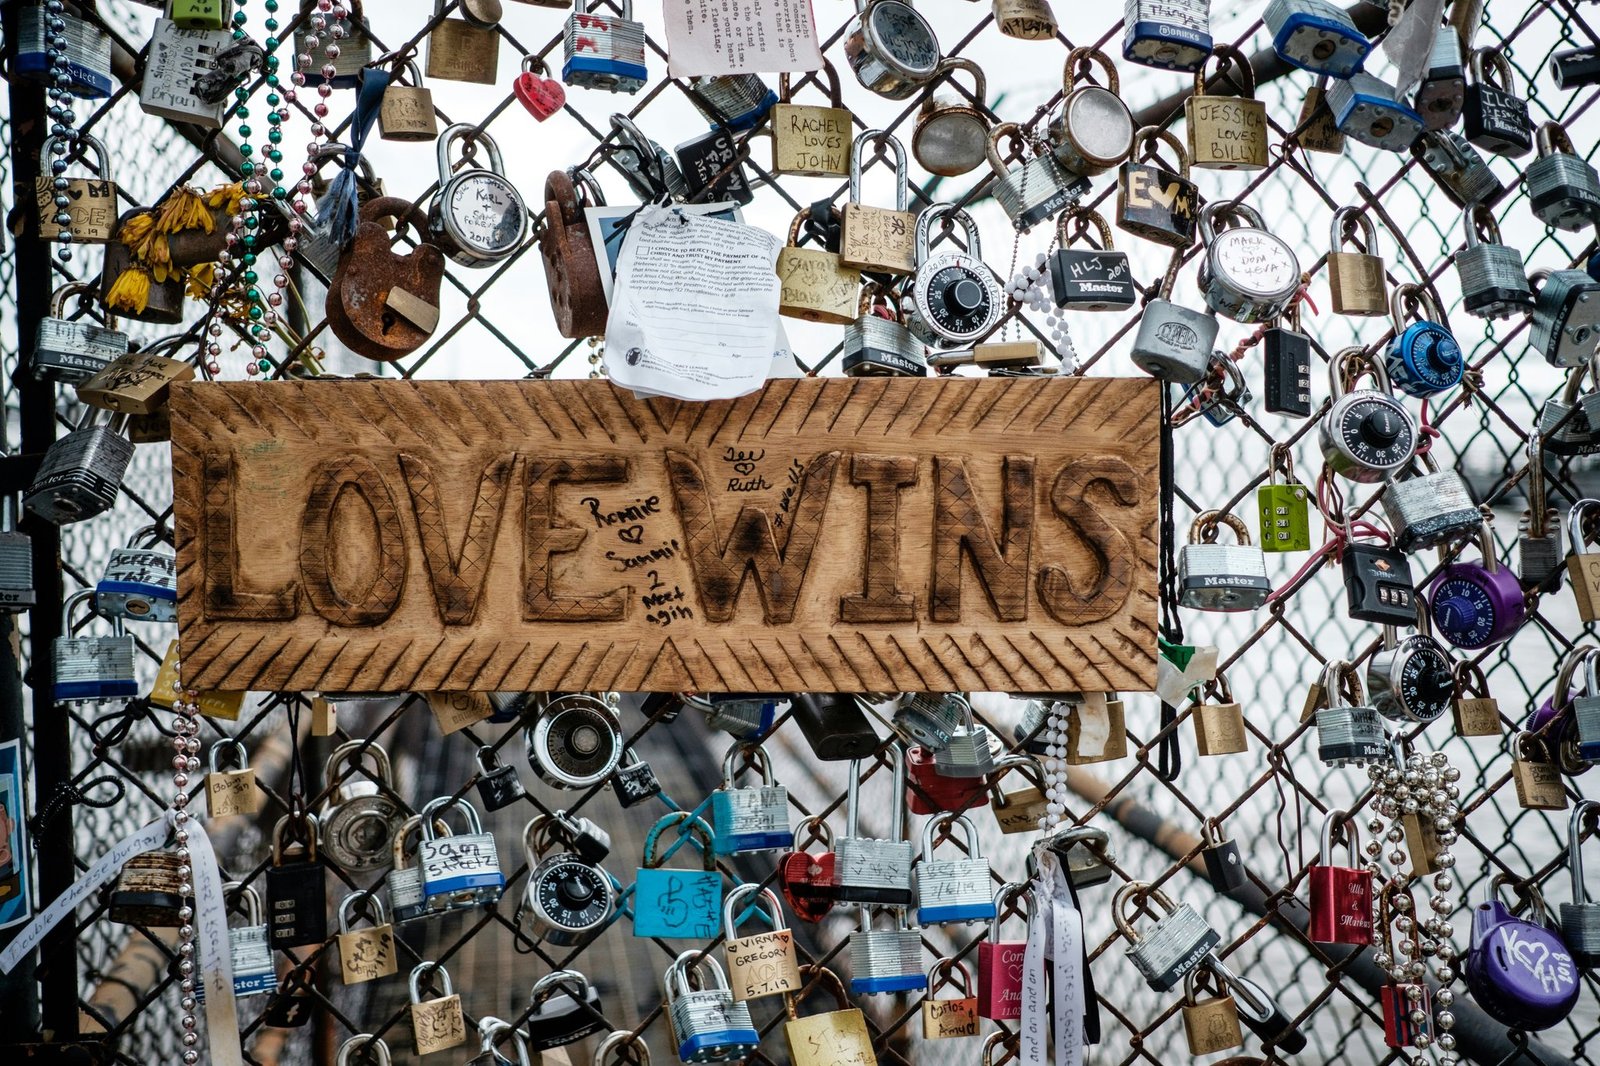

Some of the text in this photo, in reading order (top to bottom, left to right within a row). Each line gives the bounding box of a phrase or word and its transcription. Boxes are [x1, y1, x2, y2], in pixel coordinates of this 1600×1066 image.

[686, 9, 695, 36] them.
[743, 7, 751, 22] the
[775, 12, 784, 33] that
[722, 16, 737, 69] your heart
[735, 26, 746, 68] or time.
[787, 38, 797, 63] about
[66, 64, 98, 86] Select
[152, 86, 196, 107] Bryan
[1198, 104, 1263, 128] JESSICA
[791, 114, 845, 135] RACHEL
[803, 134, 842, 150] LOVES
[1217, 129, 1257, 142] LOVES
[1211, 141, 1259, 162] BILLY
[795, 152, 841, 172] JOHN
[475, 188, 503, 206] KARL
[1128, 171, 1153, 210] E
[1229, 235, 1266, 248] MARK
[710, 249, 722, 257] THE
[1069, 256, 1129, 281] HLJ 2019
[940, 274, 951, 286] 30
[934, 289, 943, 301] 25
[1079, 282, 1124, 295] Master
[938, 307, 950, 319] 20
[971, 315, 981, 325] 10
[954, 318, 964, 328] 15
[58, 353, 106, 370] Maste
[880, 352, 919, 373] Master
[1355, 412, 1364, 420] 5
[1357, 441, 1370, 453] 35
[1375, 450, 1386, 459] 30
[726, 475, 774, 493] Ruth
[580, 495, 661, 529] Ronnie
[203, 448, 1141, 628] LOVE WINS
[646, 569, 667, 592] 2
[1204, 575, 1255, 587] Master
[1461, 588, 1470, 598] 10
[1473, 599, 1483, 610] 15
[1410, 668, 1419, 679] 35
[1409, 686, 1418, 697] 30
[1363, 744, 1387, 757] Master
[557, 870, 570, 881] 30
[60, 865, 109, 907] cheese
[1348, 882, 1365, 897] Ulla
[548, 898, 560, 909] 20
[1351, 900, 1359, 911] &
[561, 910, 572, 920] 15
[578, 909, 590, 919] 10
[1339, 913, 1371, 929] Markus
[741, 933, 780, 948] VIRNA
[735, 947, 788, 967] GREGORY
[1171, 941, 1211, 978] Master
[1551, 952, 1574, 985] 2018
[233, 978, 261, 990] ster
[746, 978, 790, 998] 5.7.19
[1026, 968, 1040, 1065] and on and on
